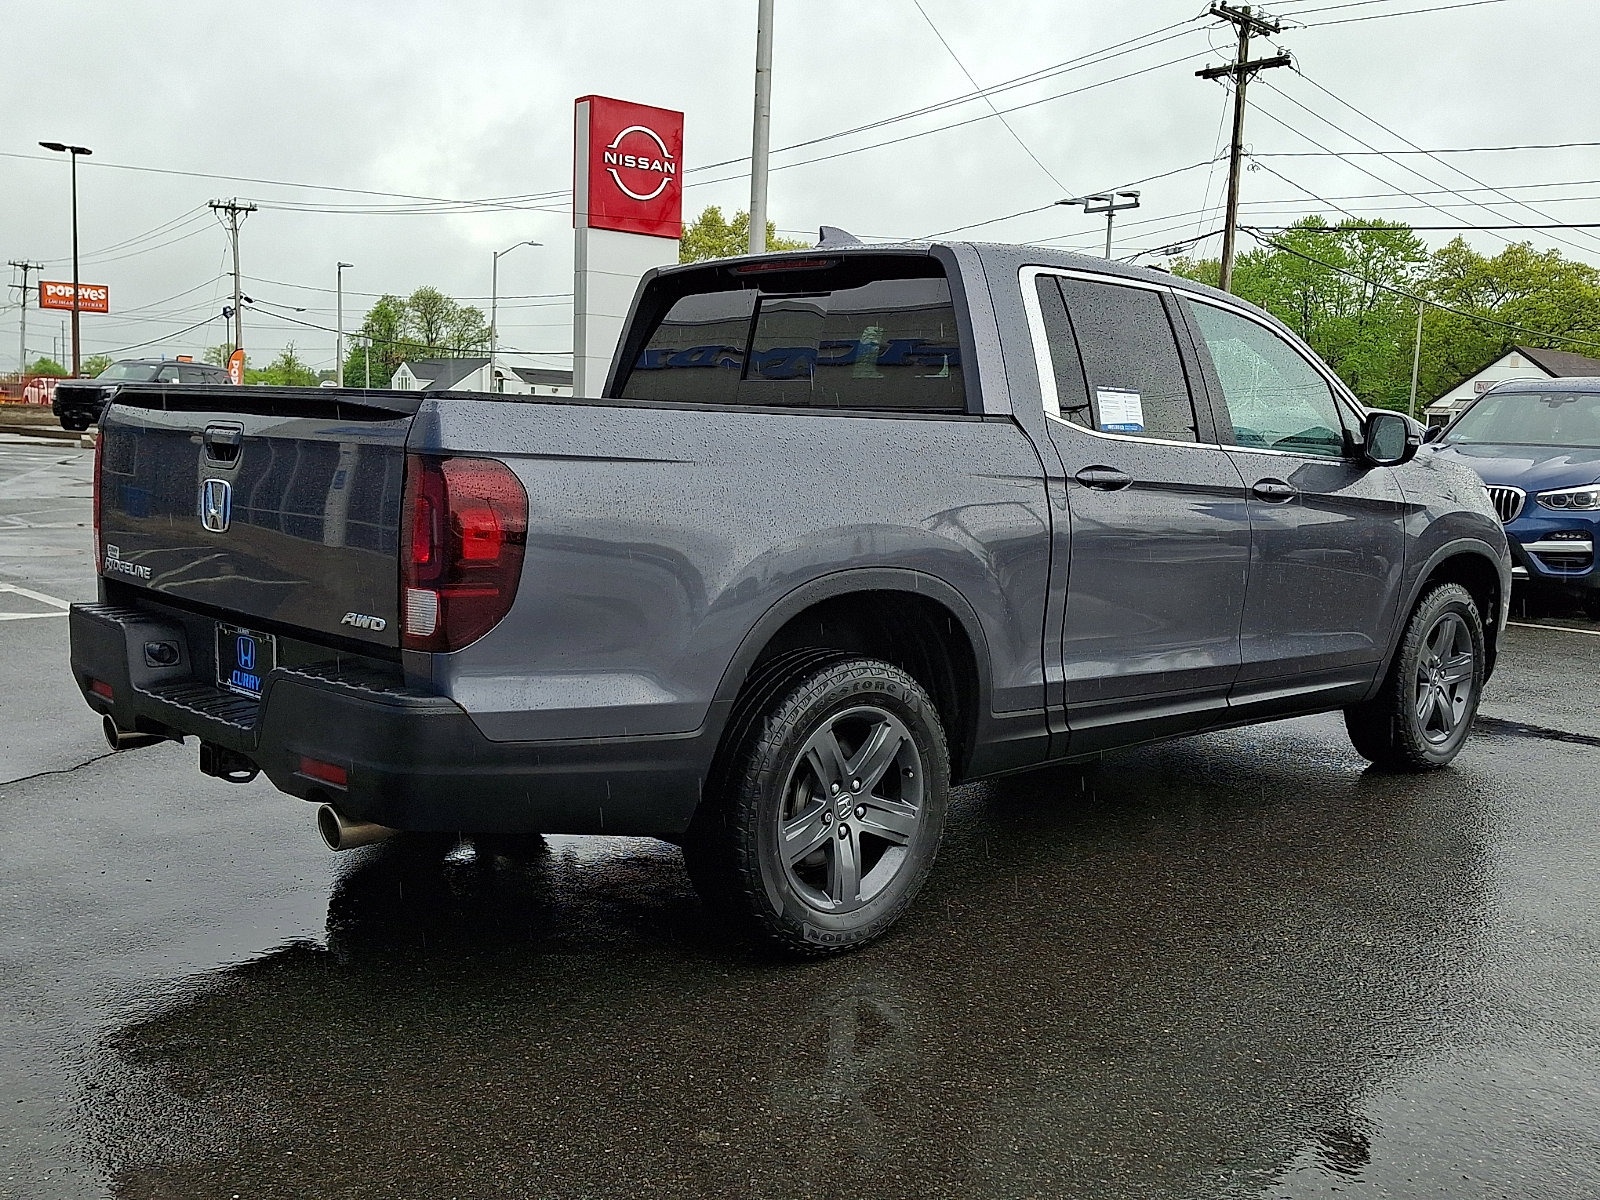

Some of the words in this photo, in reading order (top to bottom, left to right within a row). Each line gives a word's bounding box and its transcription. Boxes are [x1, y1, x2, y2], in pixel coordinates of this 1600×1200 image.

[604, 151, 676, 174] NISSAN
[105, 556, 152, 580] RIDGELINE
[340, 612, 386, 631] AWD
[232, 669, 261, 691] CURRY
